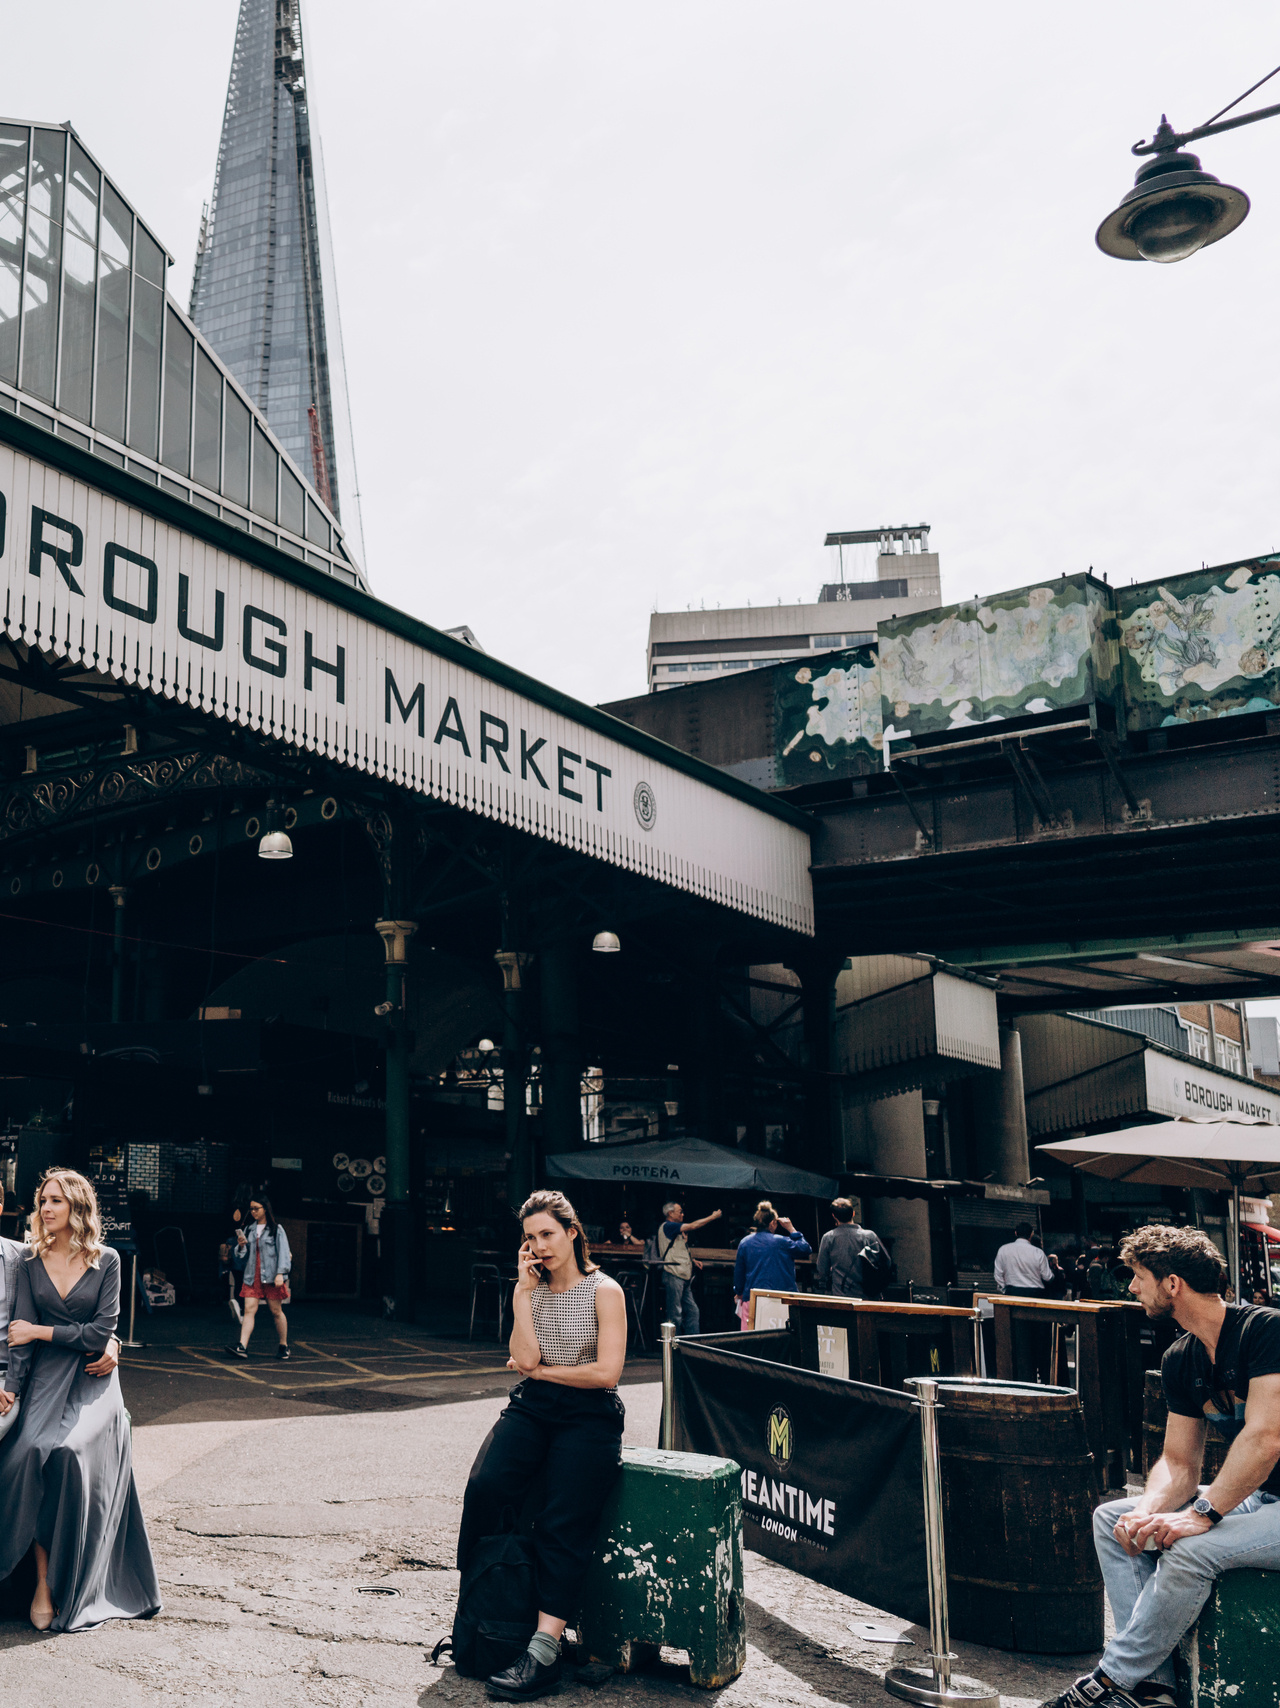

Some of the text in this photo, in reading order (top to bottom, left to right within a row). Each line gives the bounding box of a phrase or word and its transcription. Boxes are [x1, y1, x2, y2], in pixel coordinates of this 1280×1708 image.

[384, 666, 612, 813] MARKET
[1184, 1080, 1271, 1121] BOROUGH MARKET
[613, 1165, 680, 1179] PORTEÑA
[102, 1222, 132, 1231] CONFIT
[761, 1515, 798, 1542] LONDON
